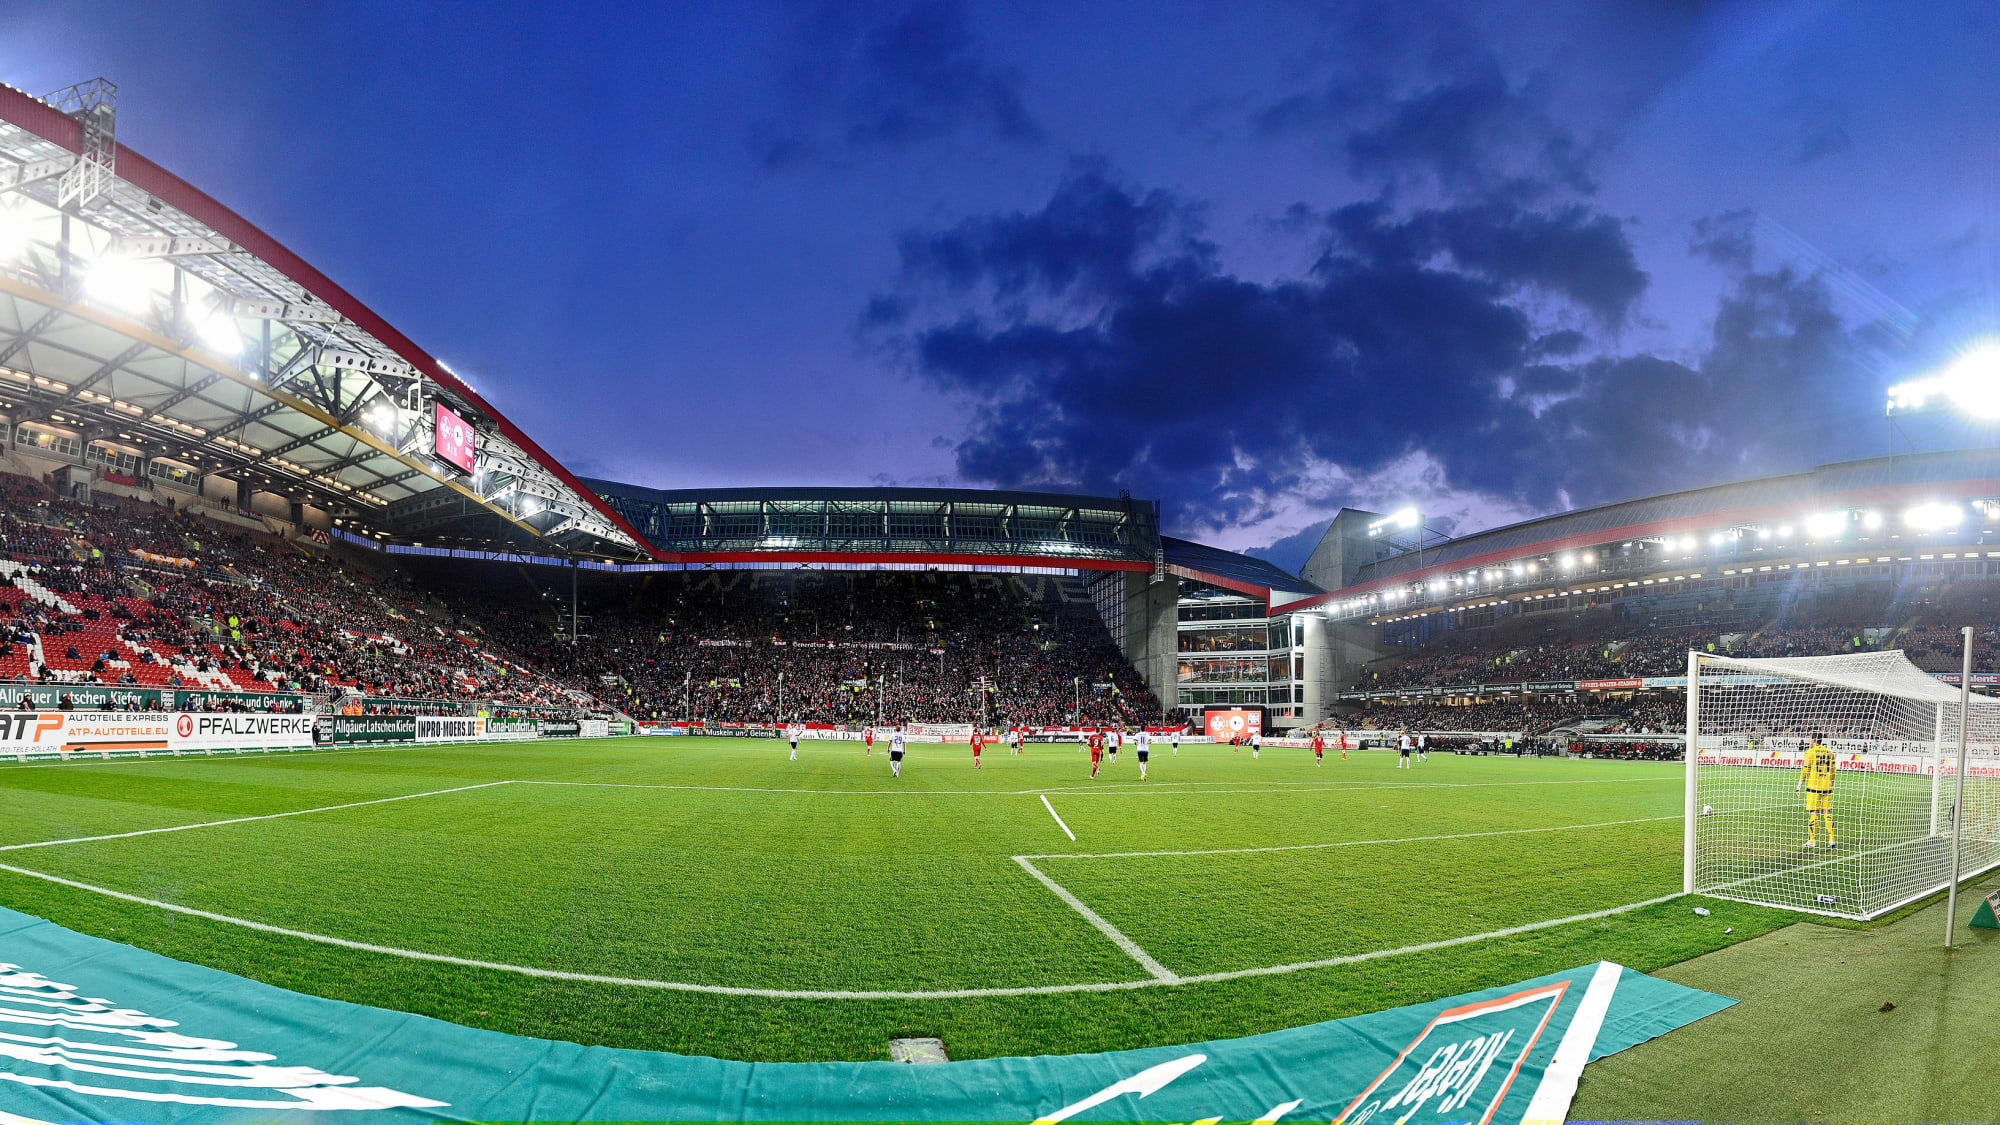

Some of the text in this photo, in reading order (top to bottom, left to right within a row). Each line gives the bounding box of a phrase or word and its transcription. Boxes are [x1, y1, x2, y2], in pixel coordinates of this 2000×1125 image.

[246, 696, 261, 708] und
[68, 714, 122, 722] AUTOTEILE
[200, 718, 311, 734] PFALZWERKE
[335, 720, 366, 736] Allgäuer
[367, 720, 396, 733] Latschen
[396, 719, 416, 733] Kiefer
[418, 720, 476, 738] INPRO-MOERS.DE
[488, 719, 536, 732] Kanal-undicht.de
[68, 728, 168, 736] ATP-AUTOTEILE.EU
[894, 736, 902, 744] 29
[1094, 738, 1098, 746] 9
